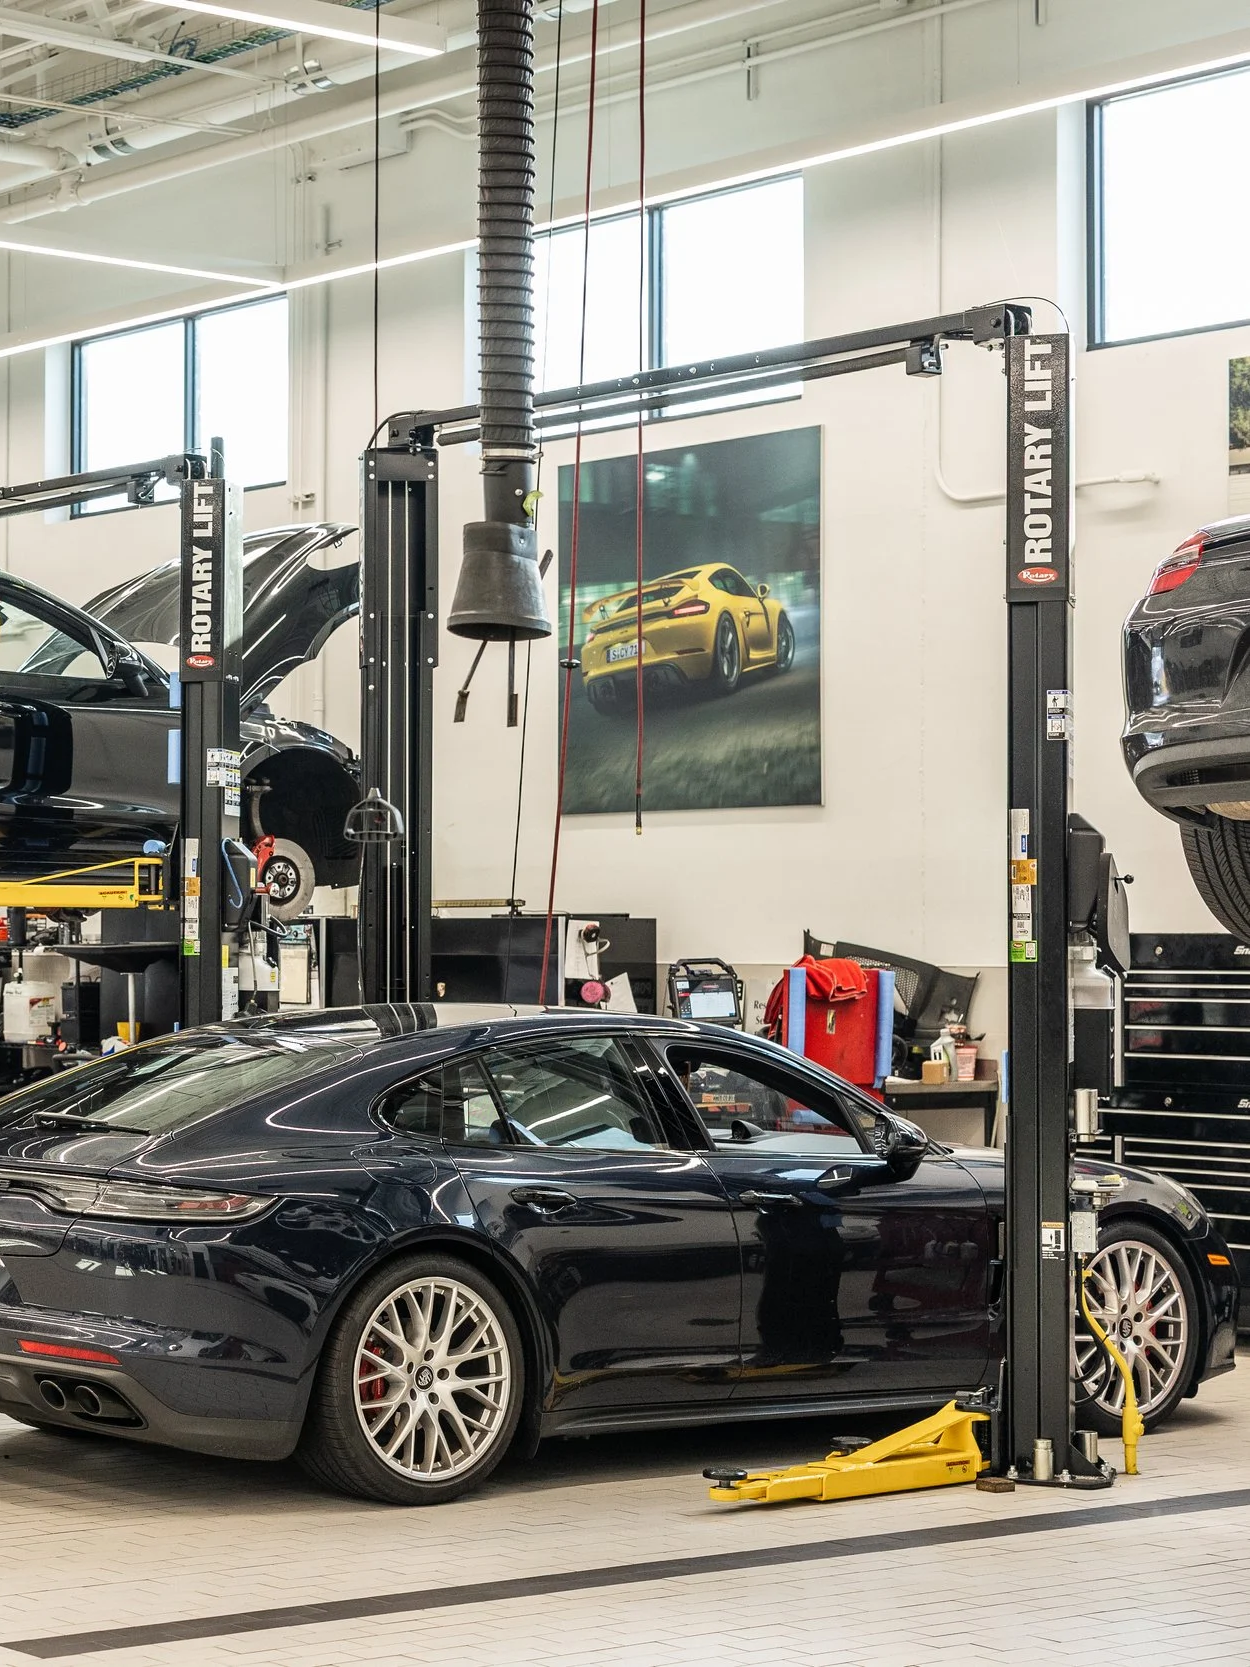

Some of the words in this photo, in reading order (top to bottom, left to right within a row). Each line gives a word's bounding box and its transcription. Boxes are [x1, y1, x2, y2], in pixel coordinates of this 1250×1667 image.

[1024, 339, 1052, 411] LIFT
[193, 482, 214, 537] LIFT
[1024, 424, 1052, 563] ROTARY
[191, 546, 213, 652] ROTARY
[1022, 570, 1054, 582] Rotary
